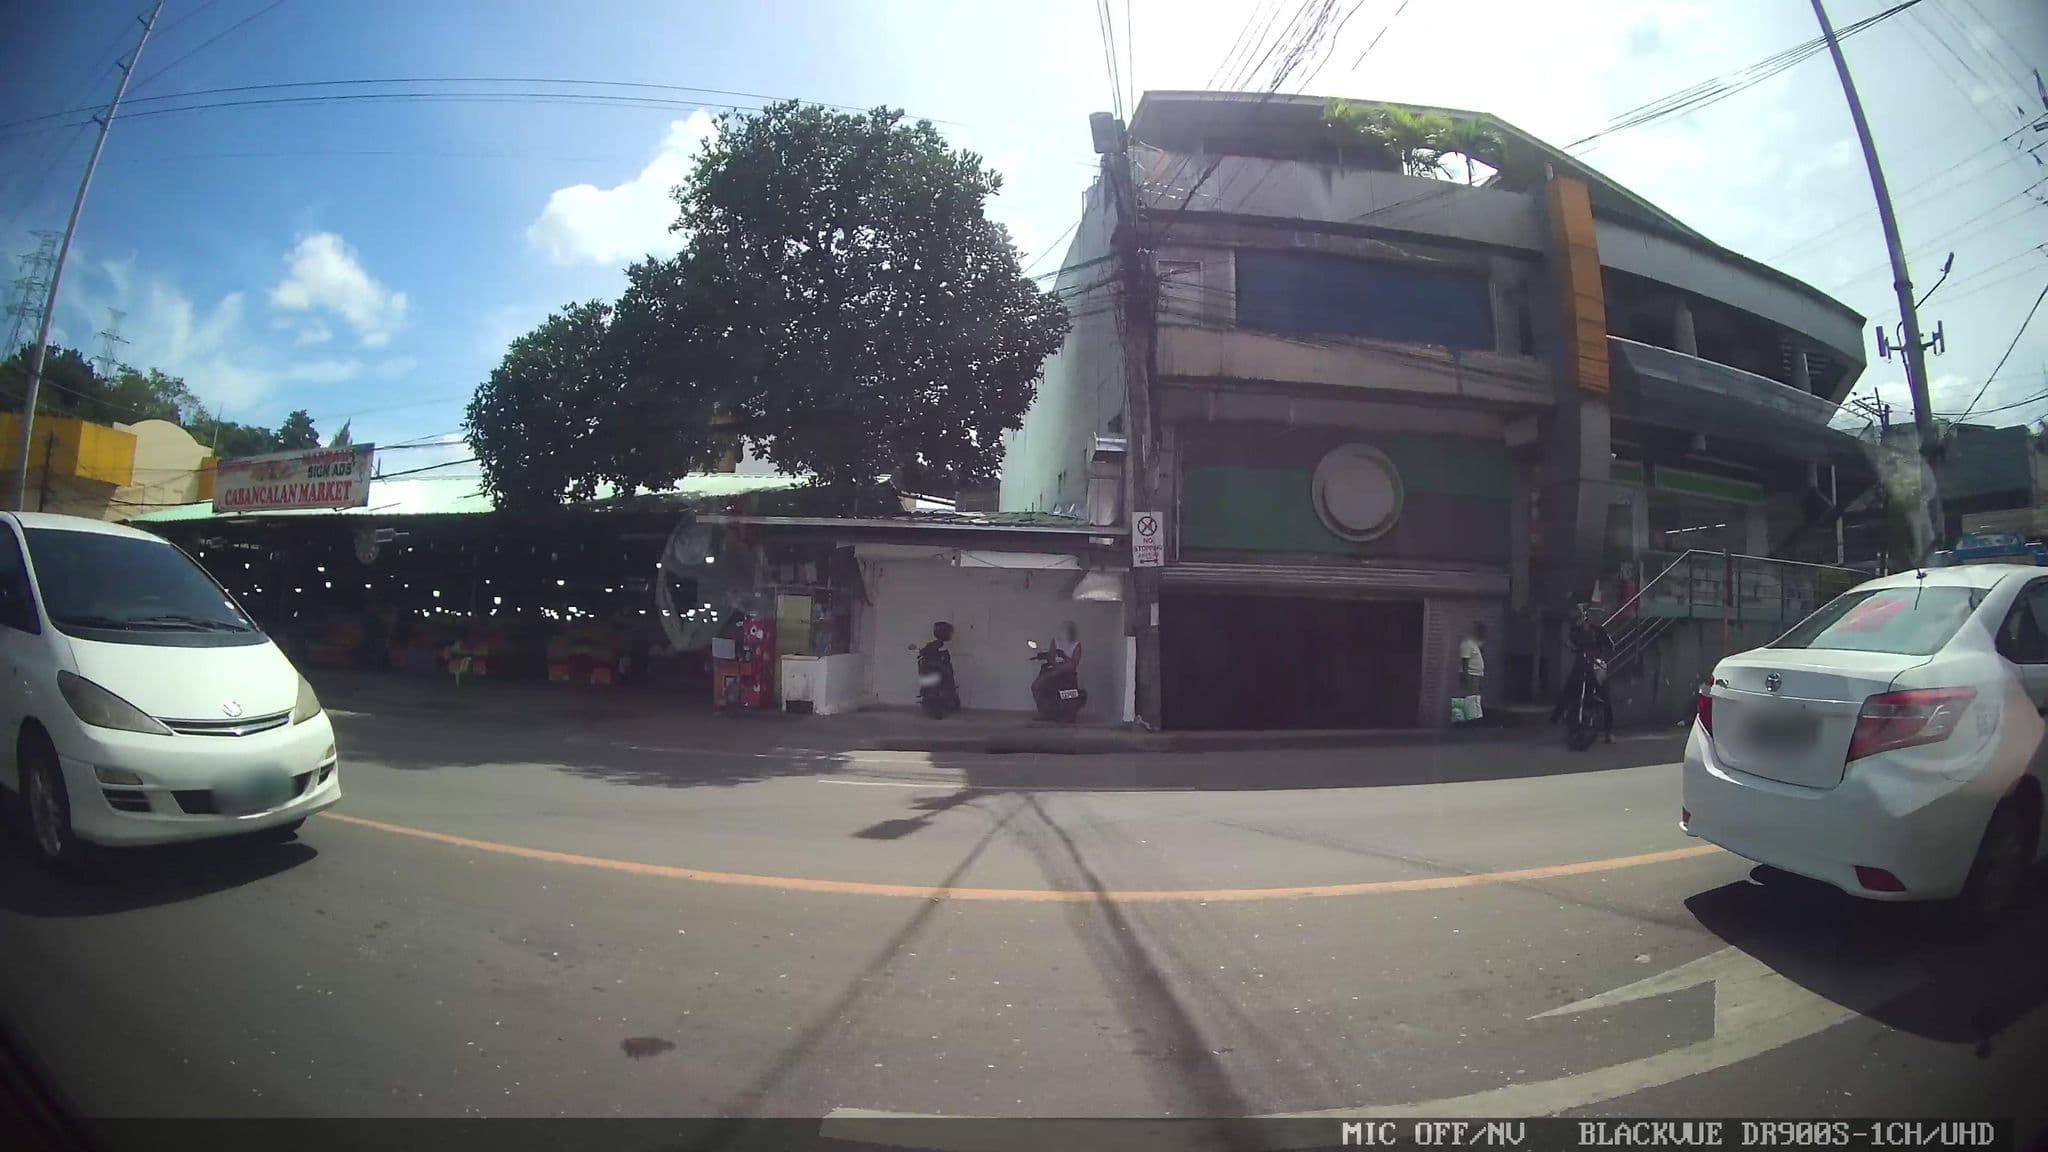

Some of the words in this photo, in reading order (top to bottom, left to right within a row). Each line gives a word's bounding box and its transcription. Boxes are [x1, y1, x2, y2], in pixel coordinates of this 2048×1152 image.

[332, 462, 352, 477] ADS
[225, 483, 298, 505] CABANCALAN
[299, 480, 353, 503] MARKET
